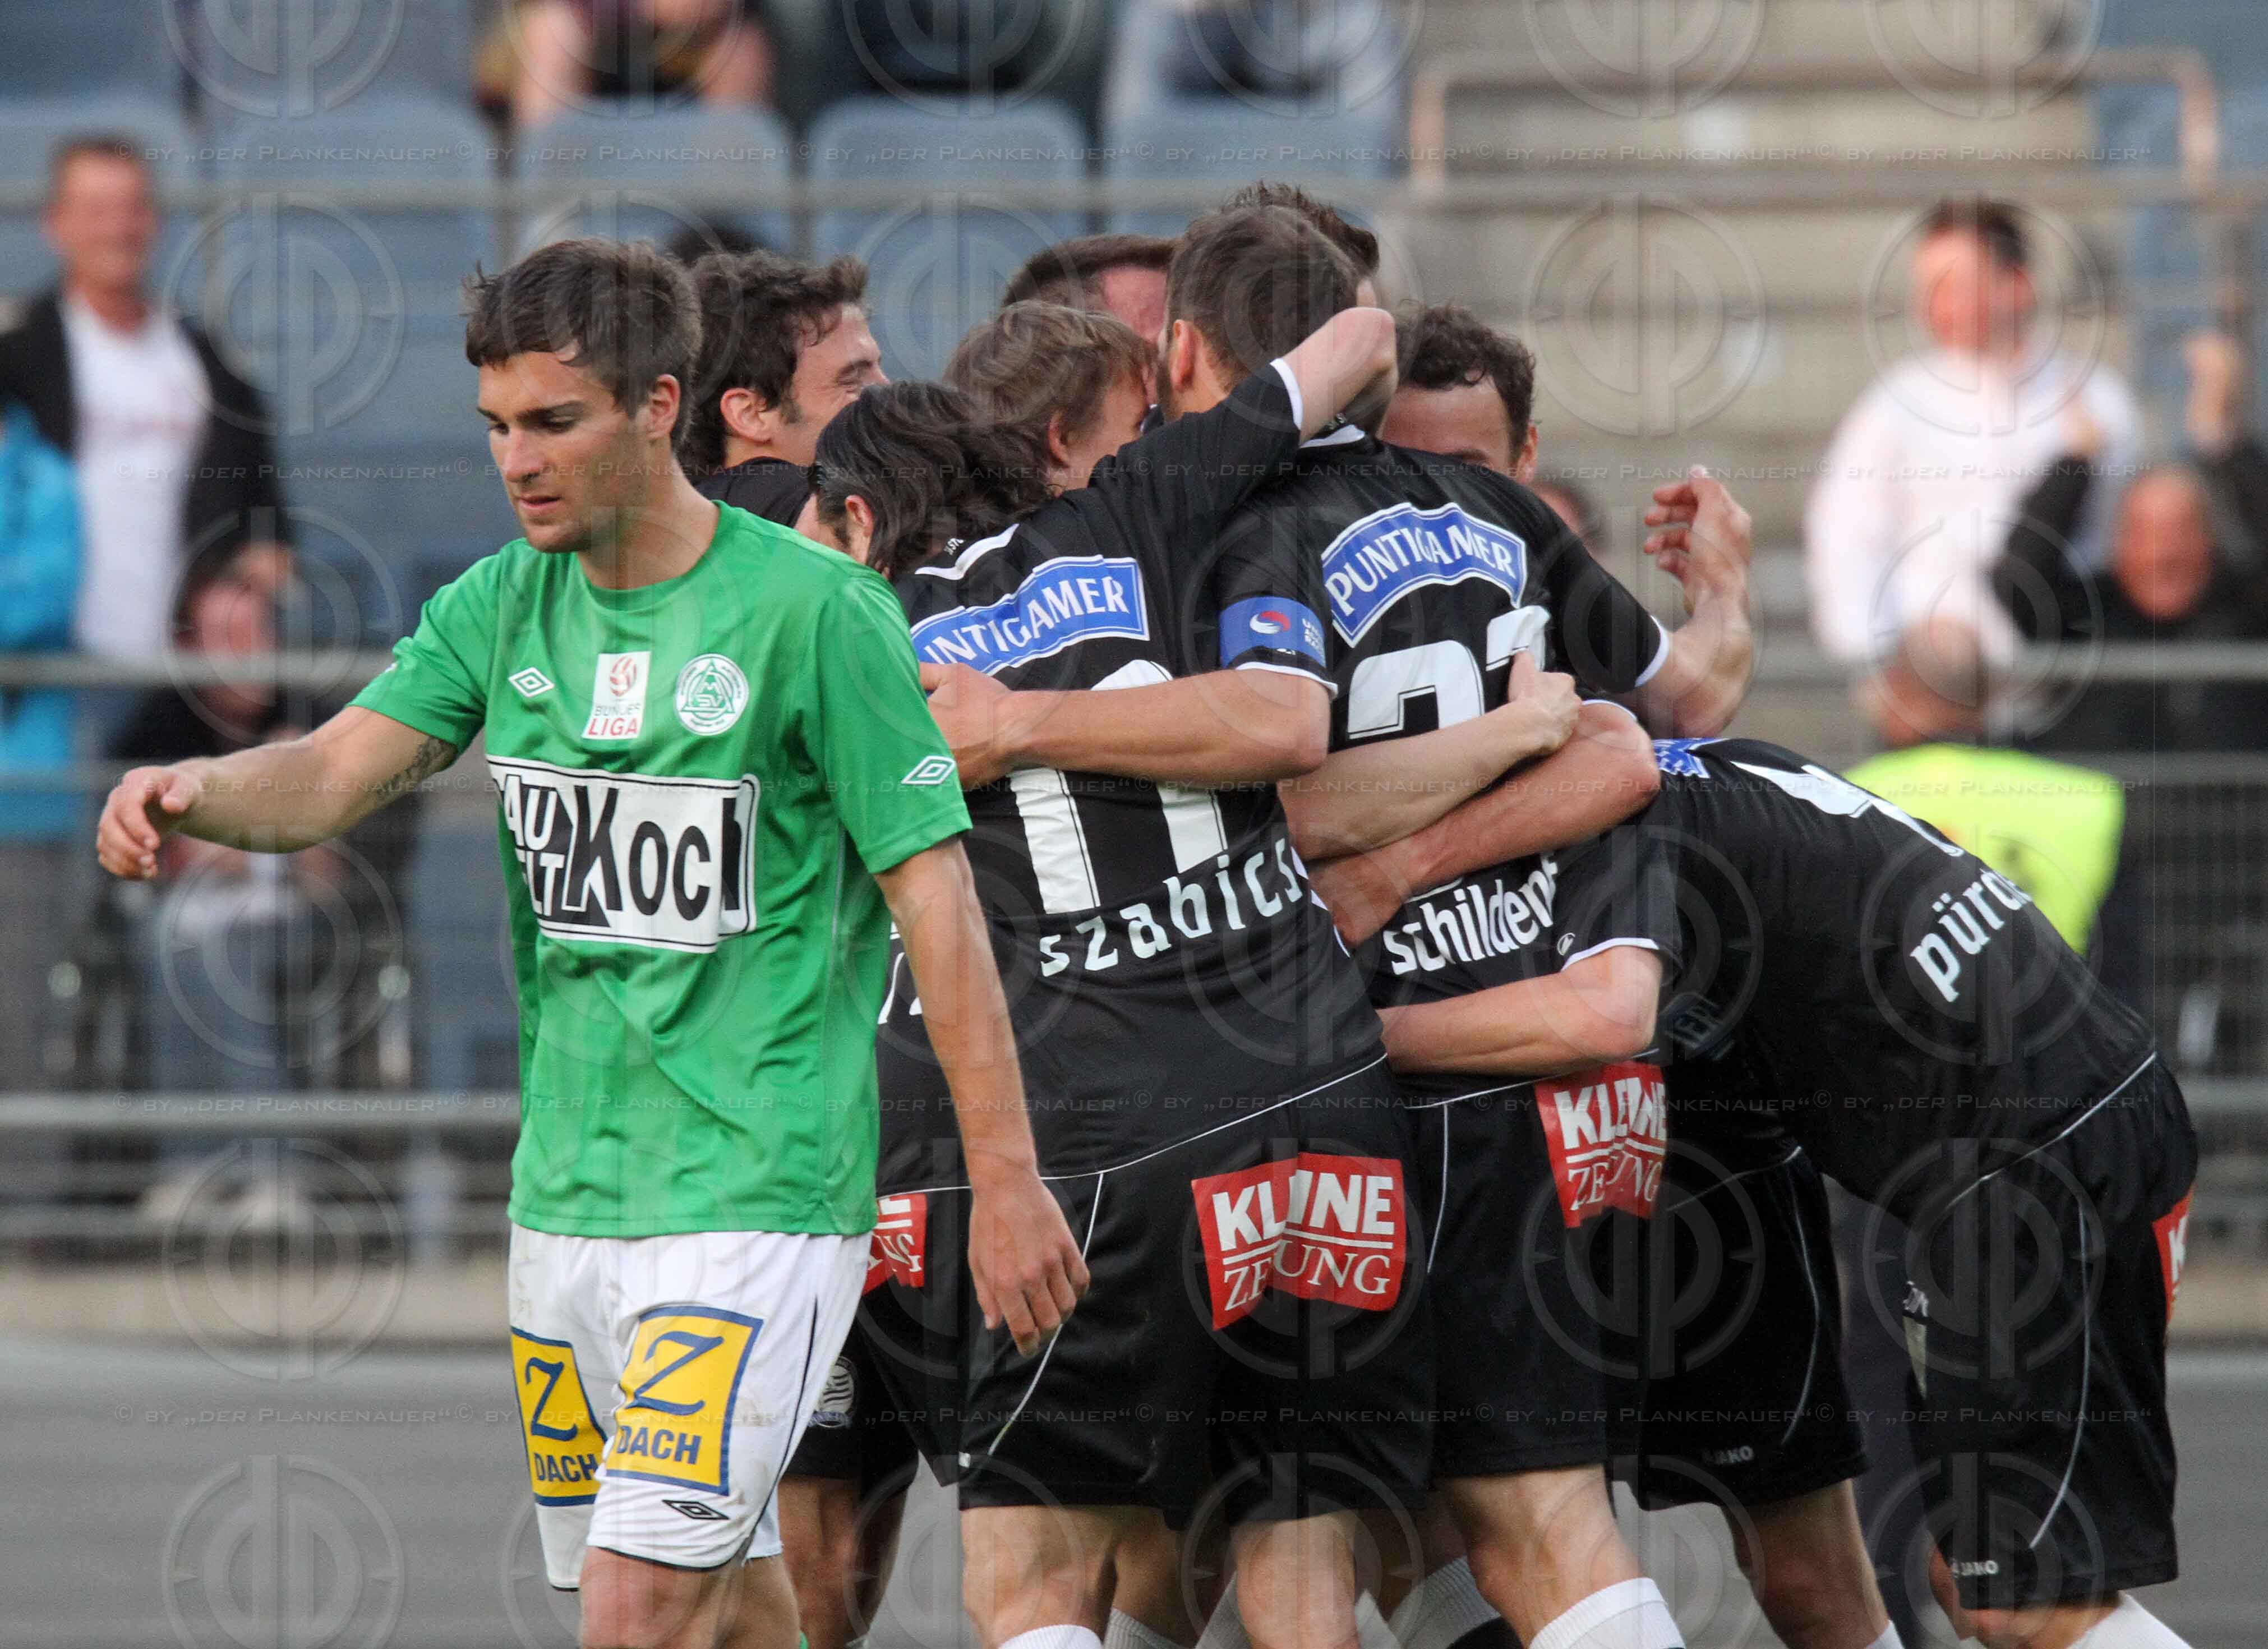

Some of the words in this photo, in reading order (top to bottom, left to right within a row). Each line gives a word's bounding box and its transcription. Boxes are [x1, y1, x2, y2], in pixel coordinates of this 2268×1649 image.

[1324, 524, 1516, 617] PUNTIGAMER
[587, 717, 638, 736] LIGA
[495, 774, 557, 851] AU
[1211, 1169, 1395, 1252] KLINE
[1223, 1238, 1391, 1311] ZEUNG
[534, 1453, 599, 1483] DACH
[616, 1425, 702, 1466] DACH
